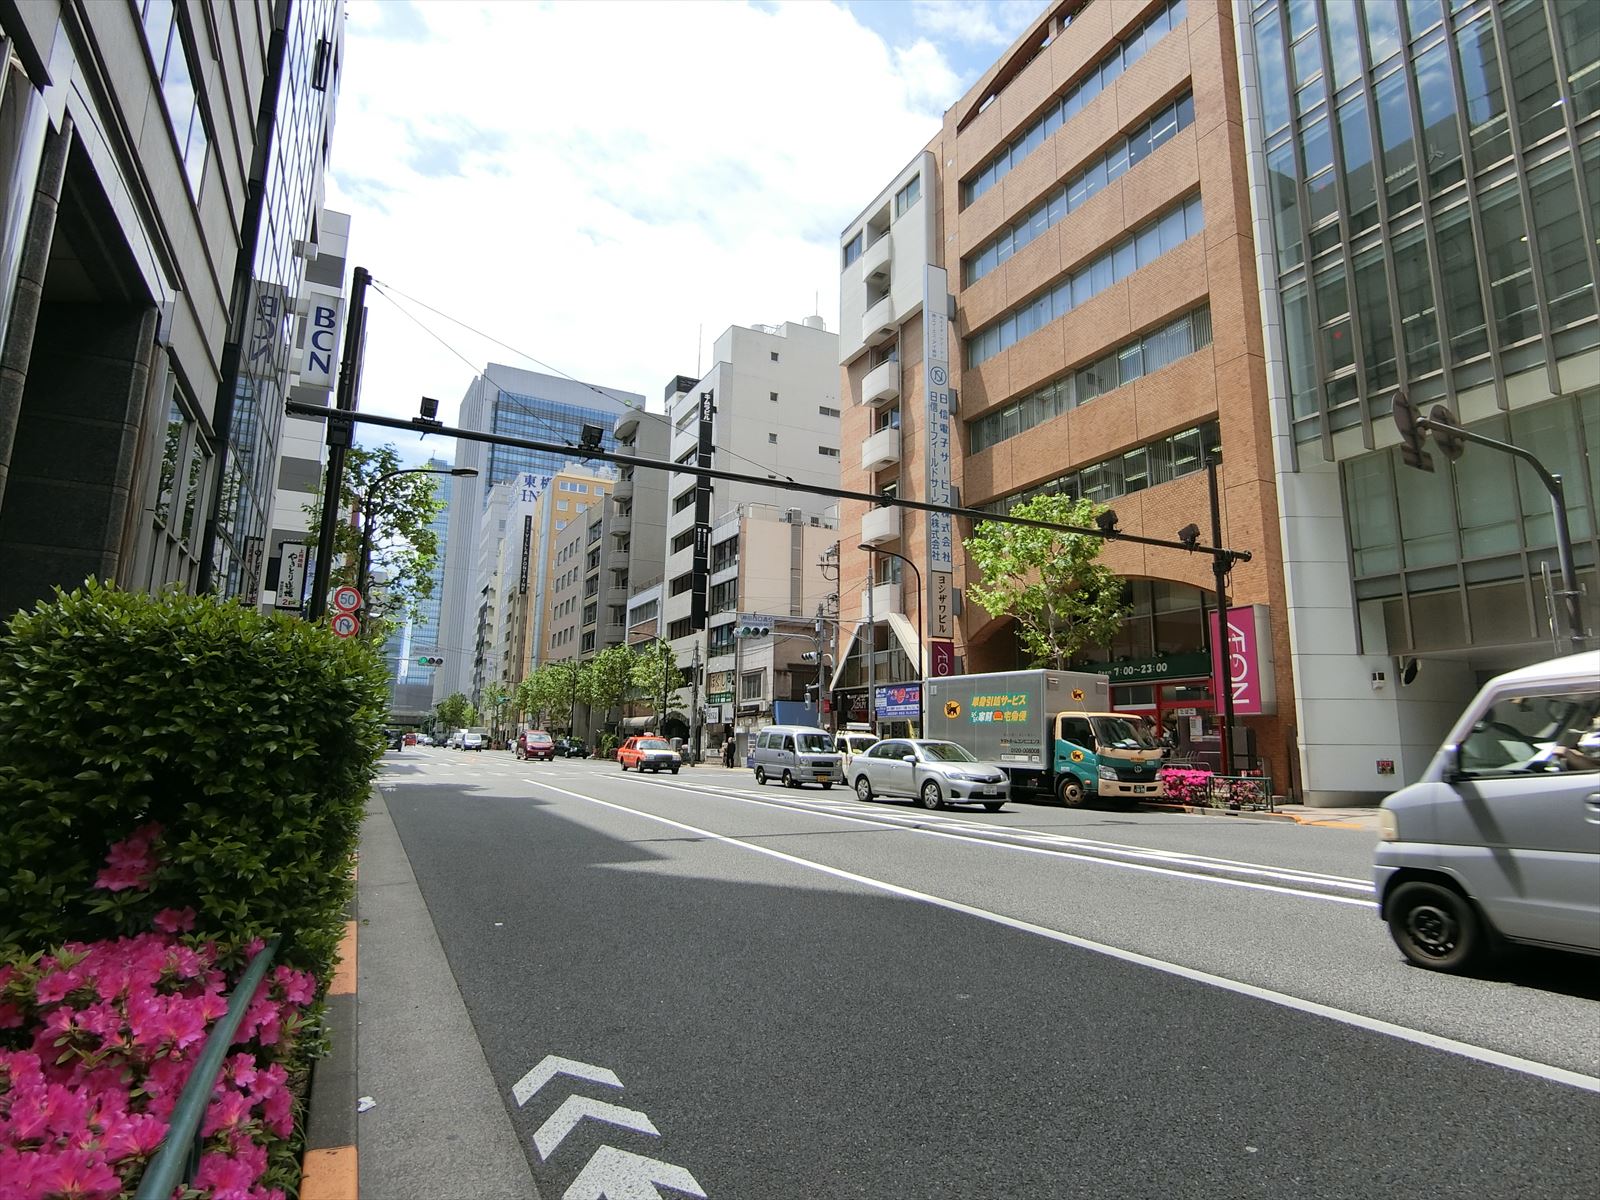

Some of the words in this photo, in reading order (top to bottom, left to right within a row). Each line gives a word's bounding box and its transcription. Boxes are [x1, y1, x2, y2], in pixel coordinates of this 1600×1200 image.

[308, 306, 336, 375] BCN
[340, 593, 355, 606] 50
[938, 576, 947, 633] ヨシザワビル
